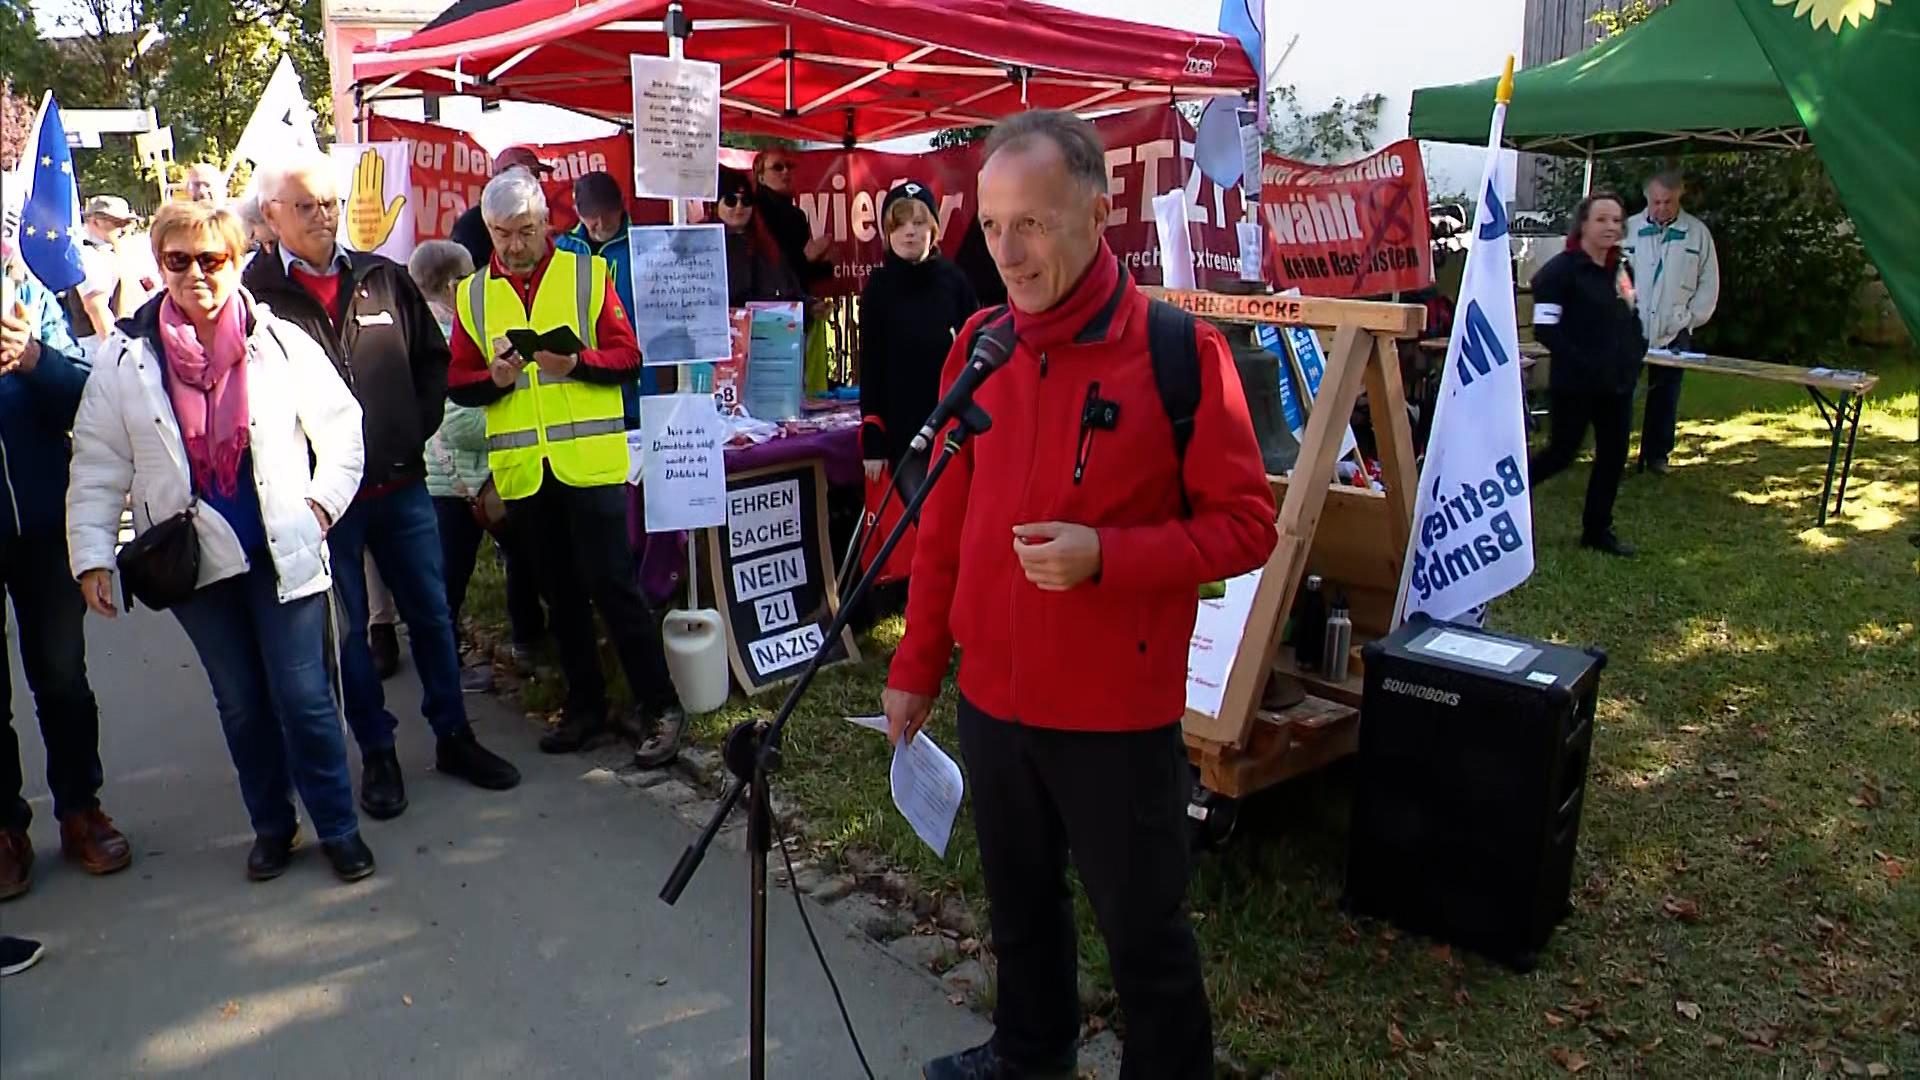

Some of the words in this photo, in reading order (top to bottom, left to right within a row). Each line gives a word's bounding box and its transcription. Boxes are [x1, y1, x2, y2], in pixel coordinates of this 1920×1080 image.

[1264, 192, 1364, 244] wählt
[1281, 252, 1329, 279] keine
[731, 488, 794, 516] EHREN
[732, 519, 800, 548] SACHE:
[740, 557, 798, 592] NEIN
[761, 600, 790, 625] ZU
[755, 631, 820, 667] NAZIS
[1382, 677, 1461, 706] SOUNDBOKS
